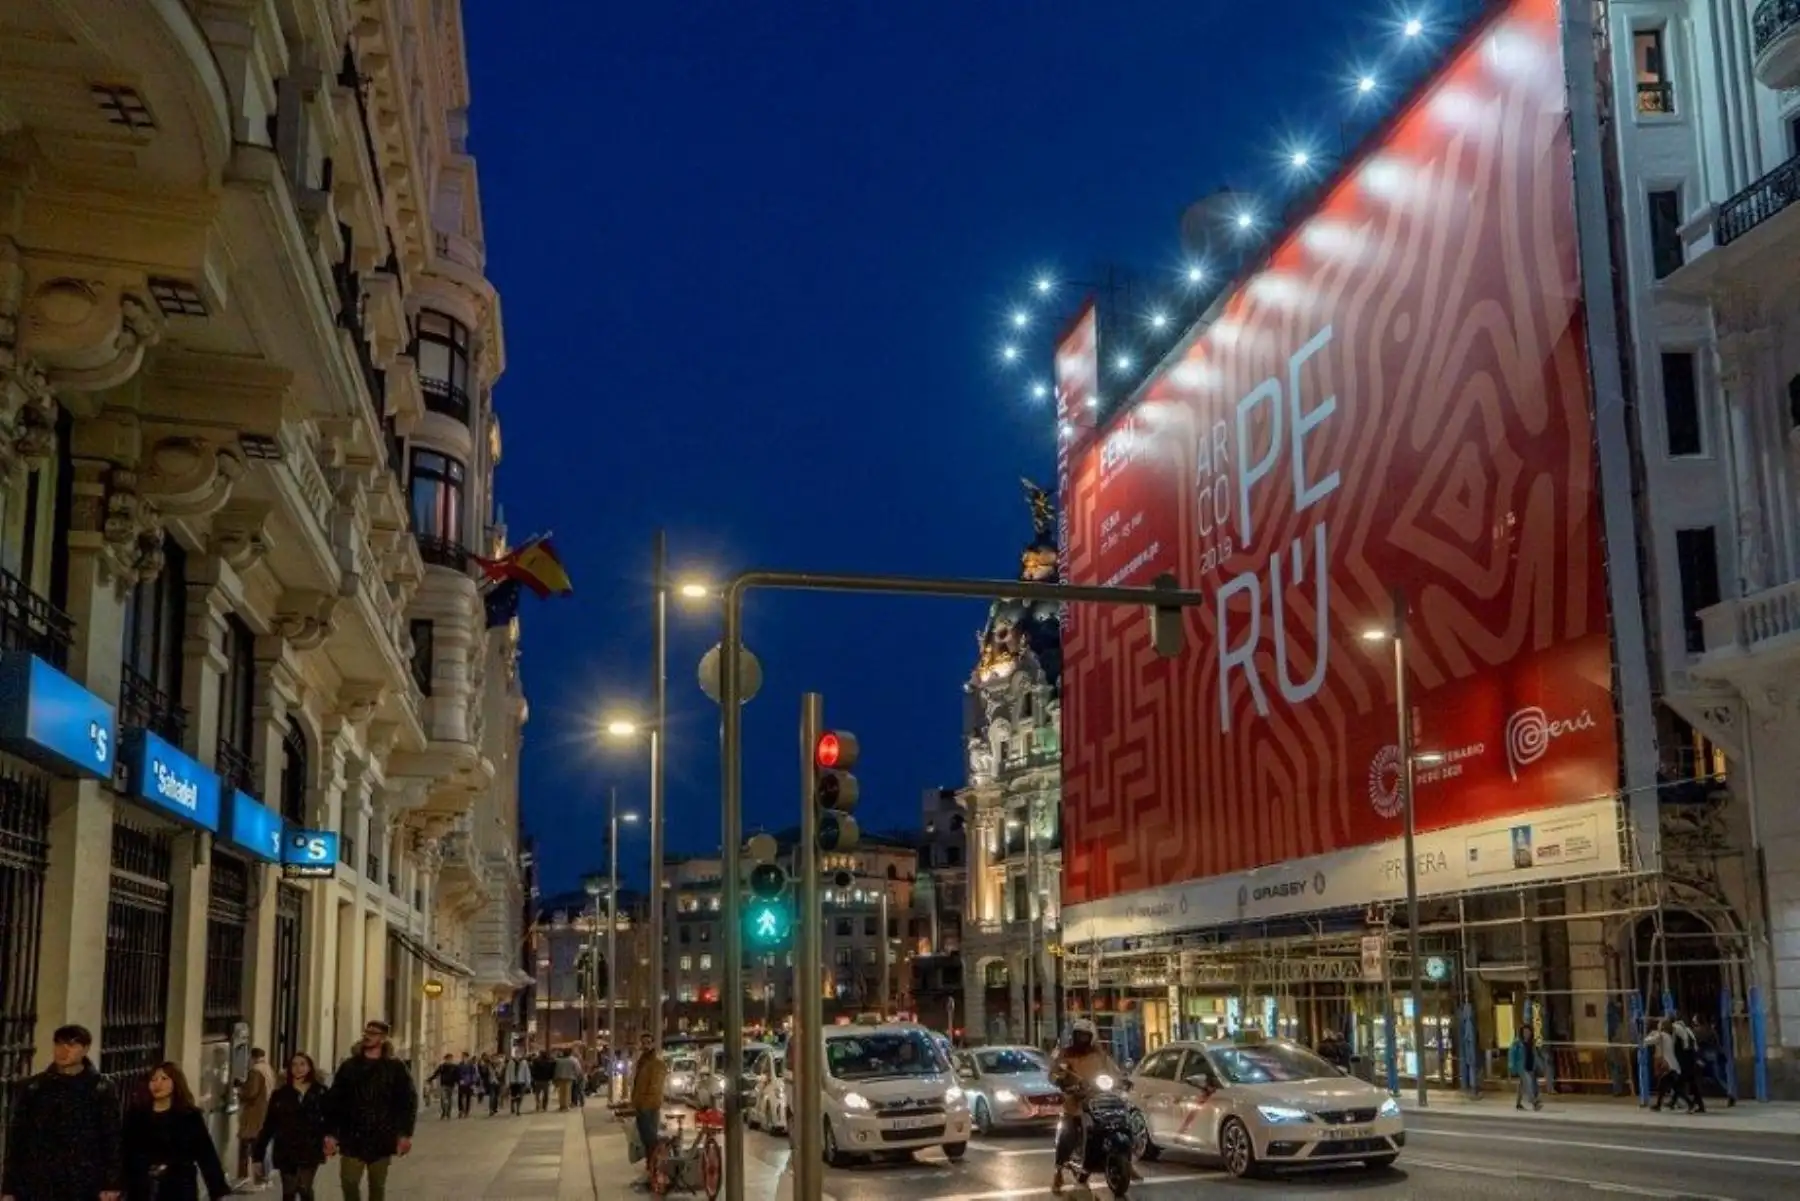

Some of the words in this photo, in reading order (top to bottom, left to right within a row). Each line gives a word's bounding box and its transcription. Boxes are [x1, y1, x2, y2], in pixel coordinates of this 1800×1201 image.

[1196, 420, 1229, 486] AR
[1237, 325, 1341, 548] PE
[1198, 475, 1230, 537] CO
[1216, 521, 1329, 734] RÚ
[1505, 705, 1596, 783] Perú
[1253, 880, 1307, 901] GRASSY
